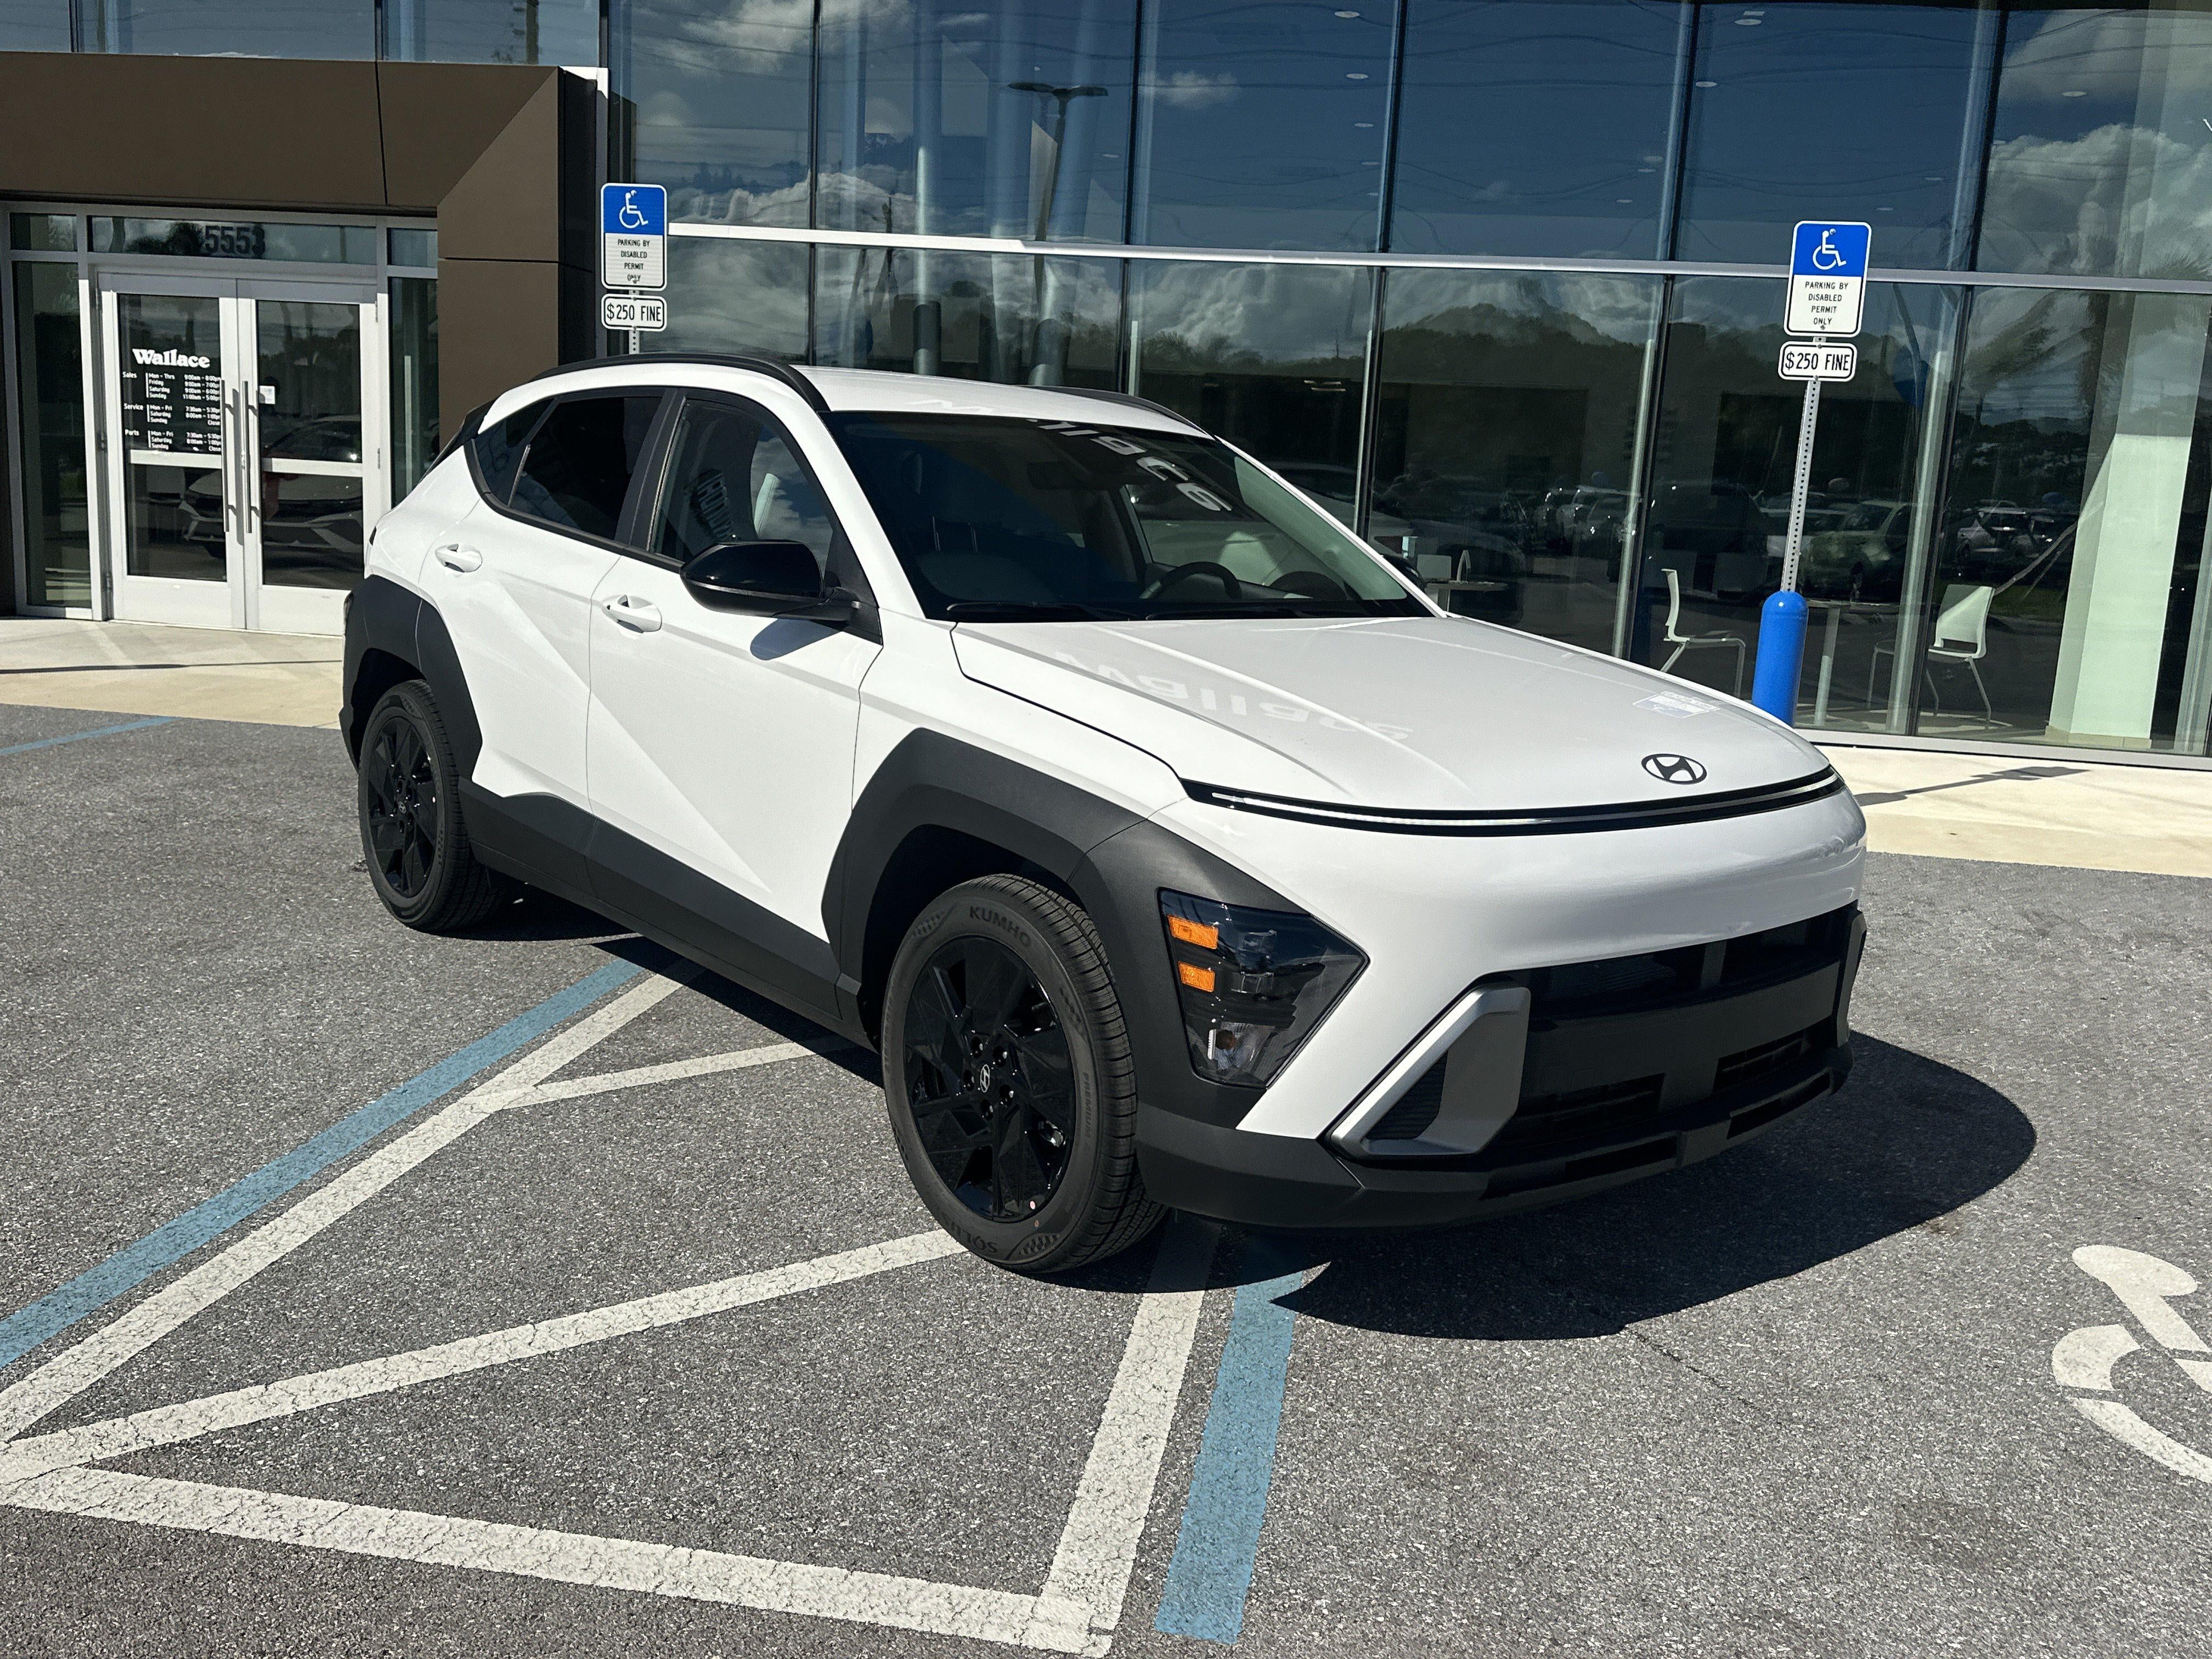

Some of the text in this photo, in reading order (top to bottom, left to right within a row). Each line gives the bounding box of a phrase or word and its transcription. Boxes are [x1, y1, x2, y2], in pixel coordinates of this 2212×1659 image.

[607, 303, 662, 321] $250 FINE
[132, 348, 210, 369] Wallace
[1785, 351, 1850, 371] $250 FINE
[968, 905, 1031, 947] KUMHO
[1081, 1071, 1093, 1138] PREMIUM
